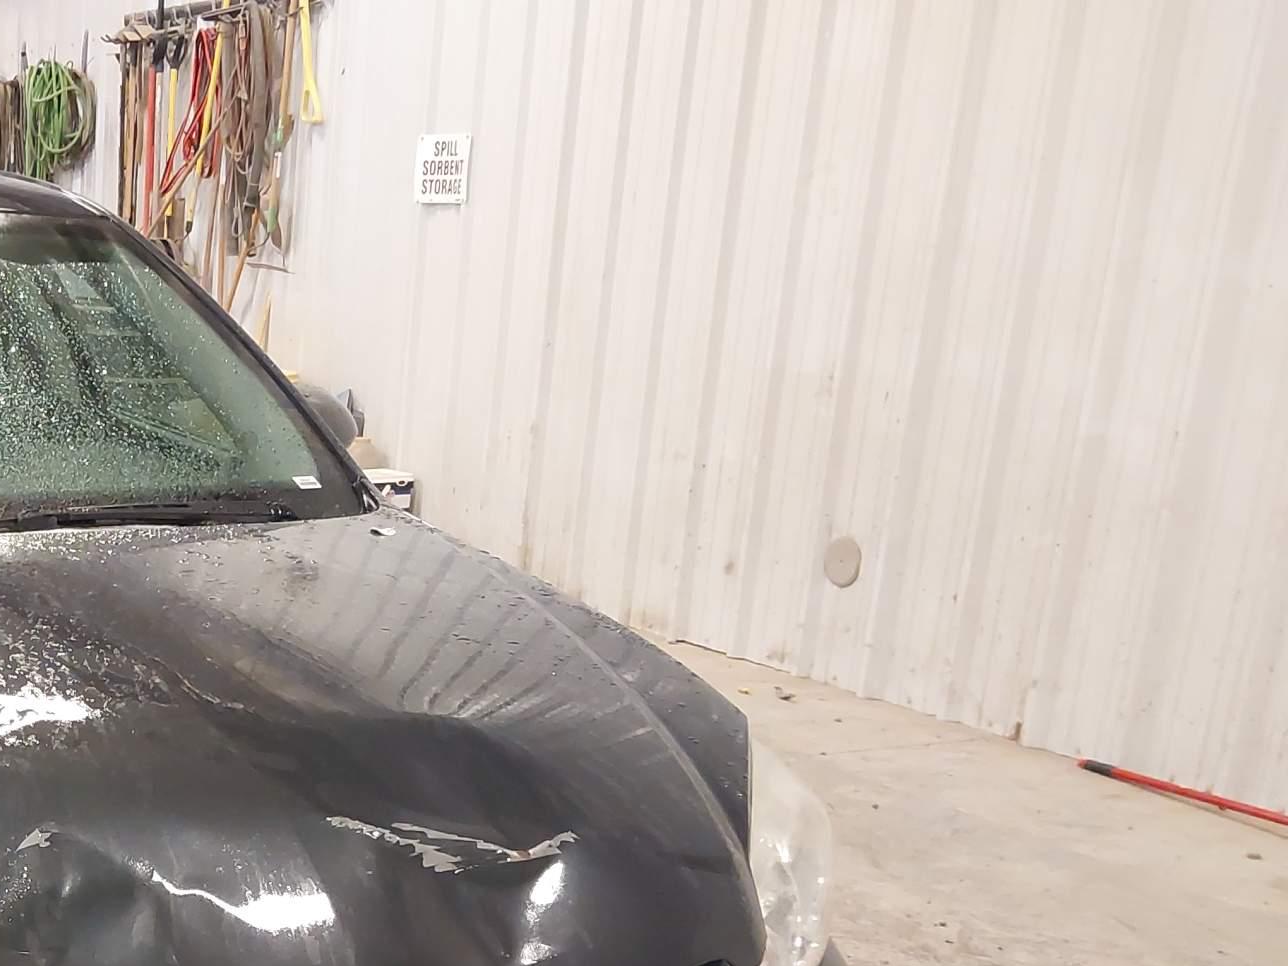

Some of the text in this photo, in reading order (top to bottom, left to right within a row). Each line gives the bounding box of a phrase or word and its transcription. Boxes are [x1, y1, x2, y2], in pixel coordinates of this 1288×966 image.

[433, 140, 459, 157] SPILL
[422, 159, 464, 176] SORBENT
[421, 178, 462, 195] STORAGE
